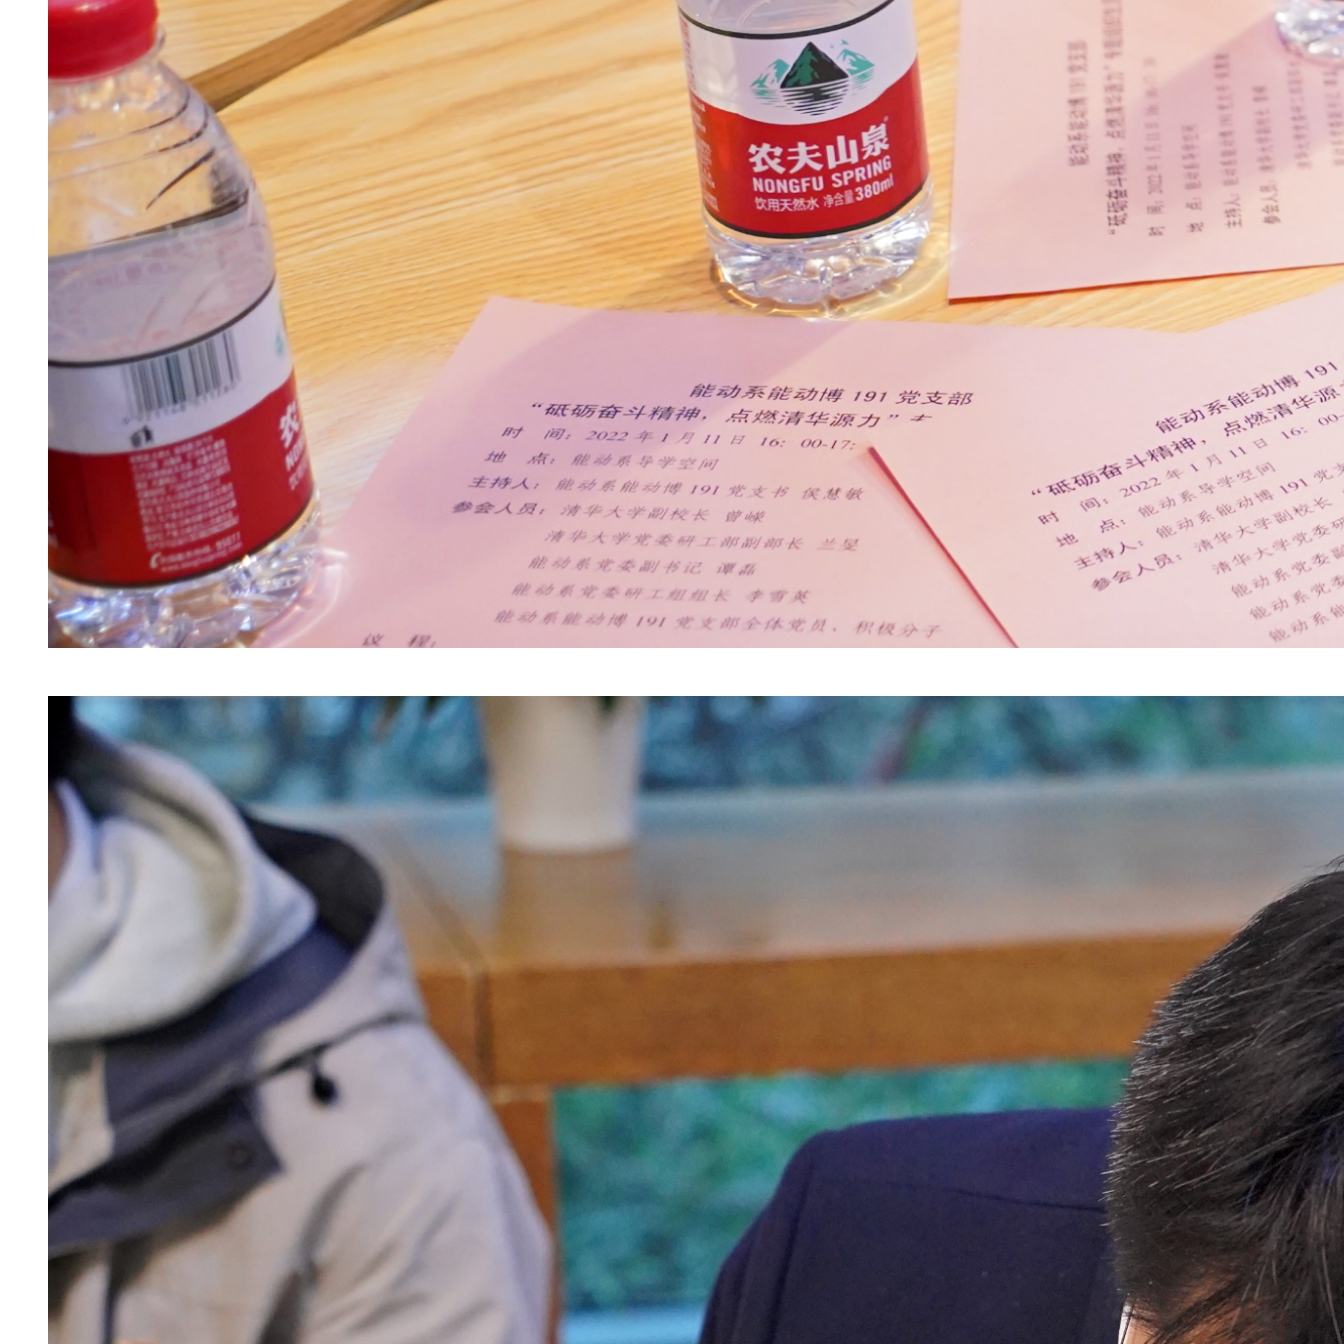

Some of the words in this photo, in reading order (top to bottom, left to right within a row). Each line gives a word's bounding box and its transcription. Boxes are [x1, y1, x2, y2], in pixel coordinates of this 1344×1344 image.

[748, 122, 891, 175] 农夫山泉
[752, 175, 825, 195] NONGFU
[831, 154, 893, 189] SPRING
[754, 196, 820, 213] 饮用天然水
[689, 382, 846, 403] 能动系能动博
[852, 391, 888, 403] 191
[895, 390, 974, 406] 党支部
[1155, 374, 1301, 434] 能动系能动博
[1303, 361, 1339, 380] 191
[531, 403, 900, 429] “砥砺奋斗精神，点燃清华源力”
[501, 426, 524, 439] 时
[585, 431, 629, 442] 2022
[634, 431, 655, 443] 年
[660, 433, 669, 443] 1
[675, 432, 696, 445] 月
[703, 434, 720, 445] 11
[730, 434, 745, 445] 日
[484, 451, 507, 464] 地
[571, 453, 719, 471] 能动系导学空间
[468, 476, 540, 490] 主持人：
[555, 478, 683, 496] 能动系能动博
[689, 485, 719, 496] 191
[1038, 511, 1060, 525] 时
[1119, 476, 1162, 498] 2022
[1165, 468, 1185, 480] 年
[1190, 463, 1199, 472] 1
[1206, 453, 1222, 468] 月
[1229, 446, 1247, 458] 11
[1252, 437, 1268, 449] 日
[451, 501, 546, 516] 参会人员：
[560, 503, 710, 522] 清华大学副校长
[1056, 532, 1079, 547] 地
[1138, 461, 1277, 518] 能动系导学空间
[1074, 540, 1144, 570] 主持人：
[1156, 488, 1275, 539] 能动系能动博
[1279, 478, 1310, 496] 191
[1092, 553, 1182, 592] 参会人员：
[1194, 497, 1333, 553] 清华大学副校长
